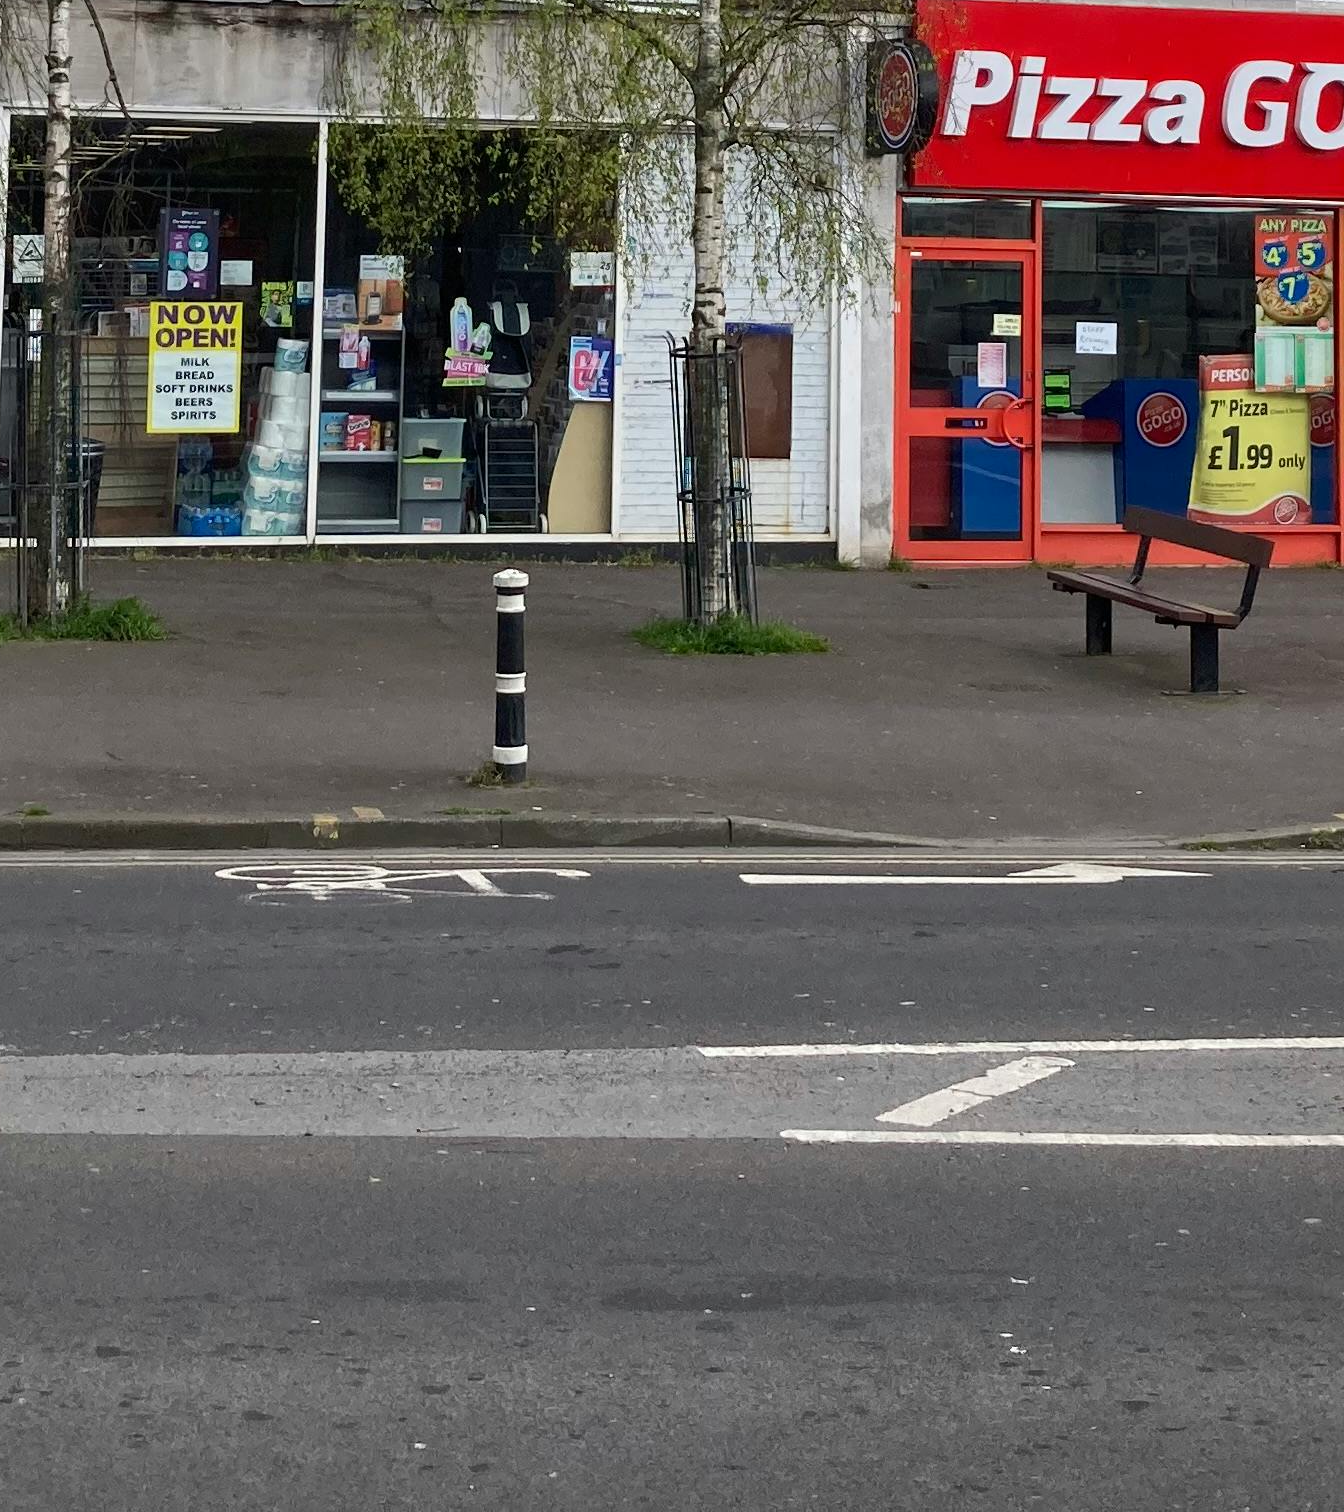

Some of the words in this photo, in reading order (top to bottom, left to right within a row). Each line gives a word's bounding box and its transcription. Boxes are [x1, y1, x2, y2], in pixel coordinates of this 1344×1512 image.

[940, 50, 1206, 145] Pizza
[1259, 218, 1288, 232] ANY
[1290, 219, 1327, 233] PIZZA
[157, 305, 237, 325] NOW
[156, 328, 236, 348] OPEN!
[181, 357, 210, 367] MILK
[175, 370, 215, 380] BREAD
[155, 384, 185, 394] SOFT
[189, 384, 233, 394] DRINKS
[175, 397, 213, 407] BEERS
[1229, 399, 1268, 417] Pizza
[170, 410, 217, 420] SPIRITS
[1142, 406, 1181, 433] GOGO
[1208, 425, 1273, 471] £1.99
[1278, 453, 1306, 471] only
